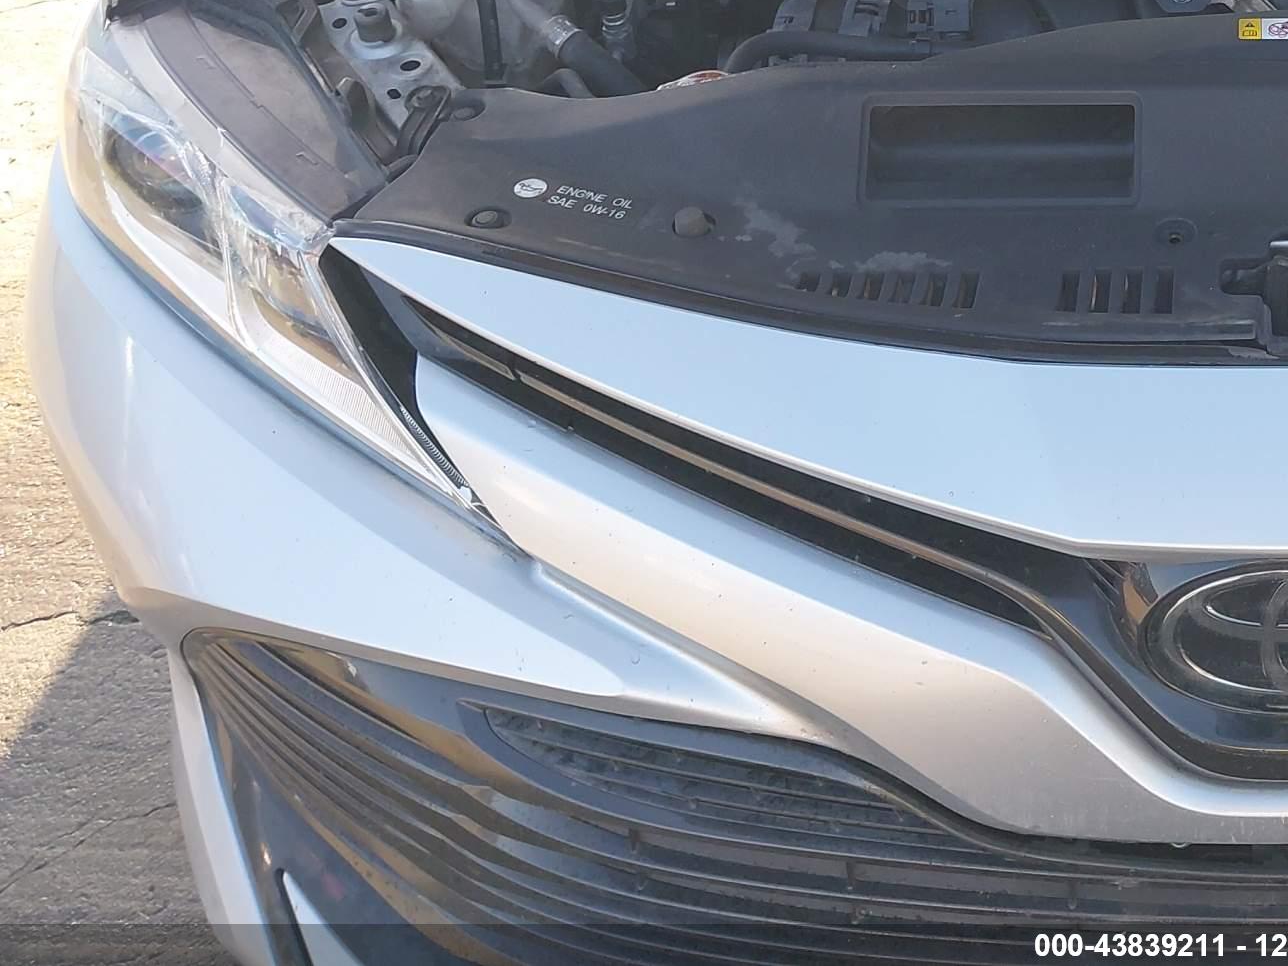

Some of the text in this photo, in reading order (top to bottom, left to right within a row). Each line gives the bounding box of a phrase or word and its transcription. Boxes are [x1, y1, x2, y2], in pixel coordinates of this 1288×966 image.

[547, 195, 626, 219] SAE 0W-16
[556, 185, 633, 209] ENGINE OIL
